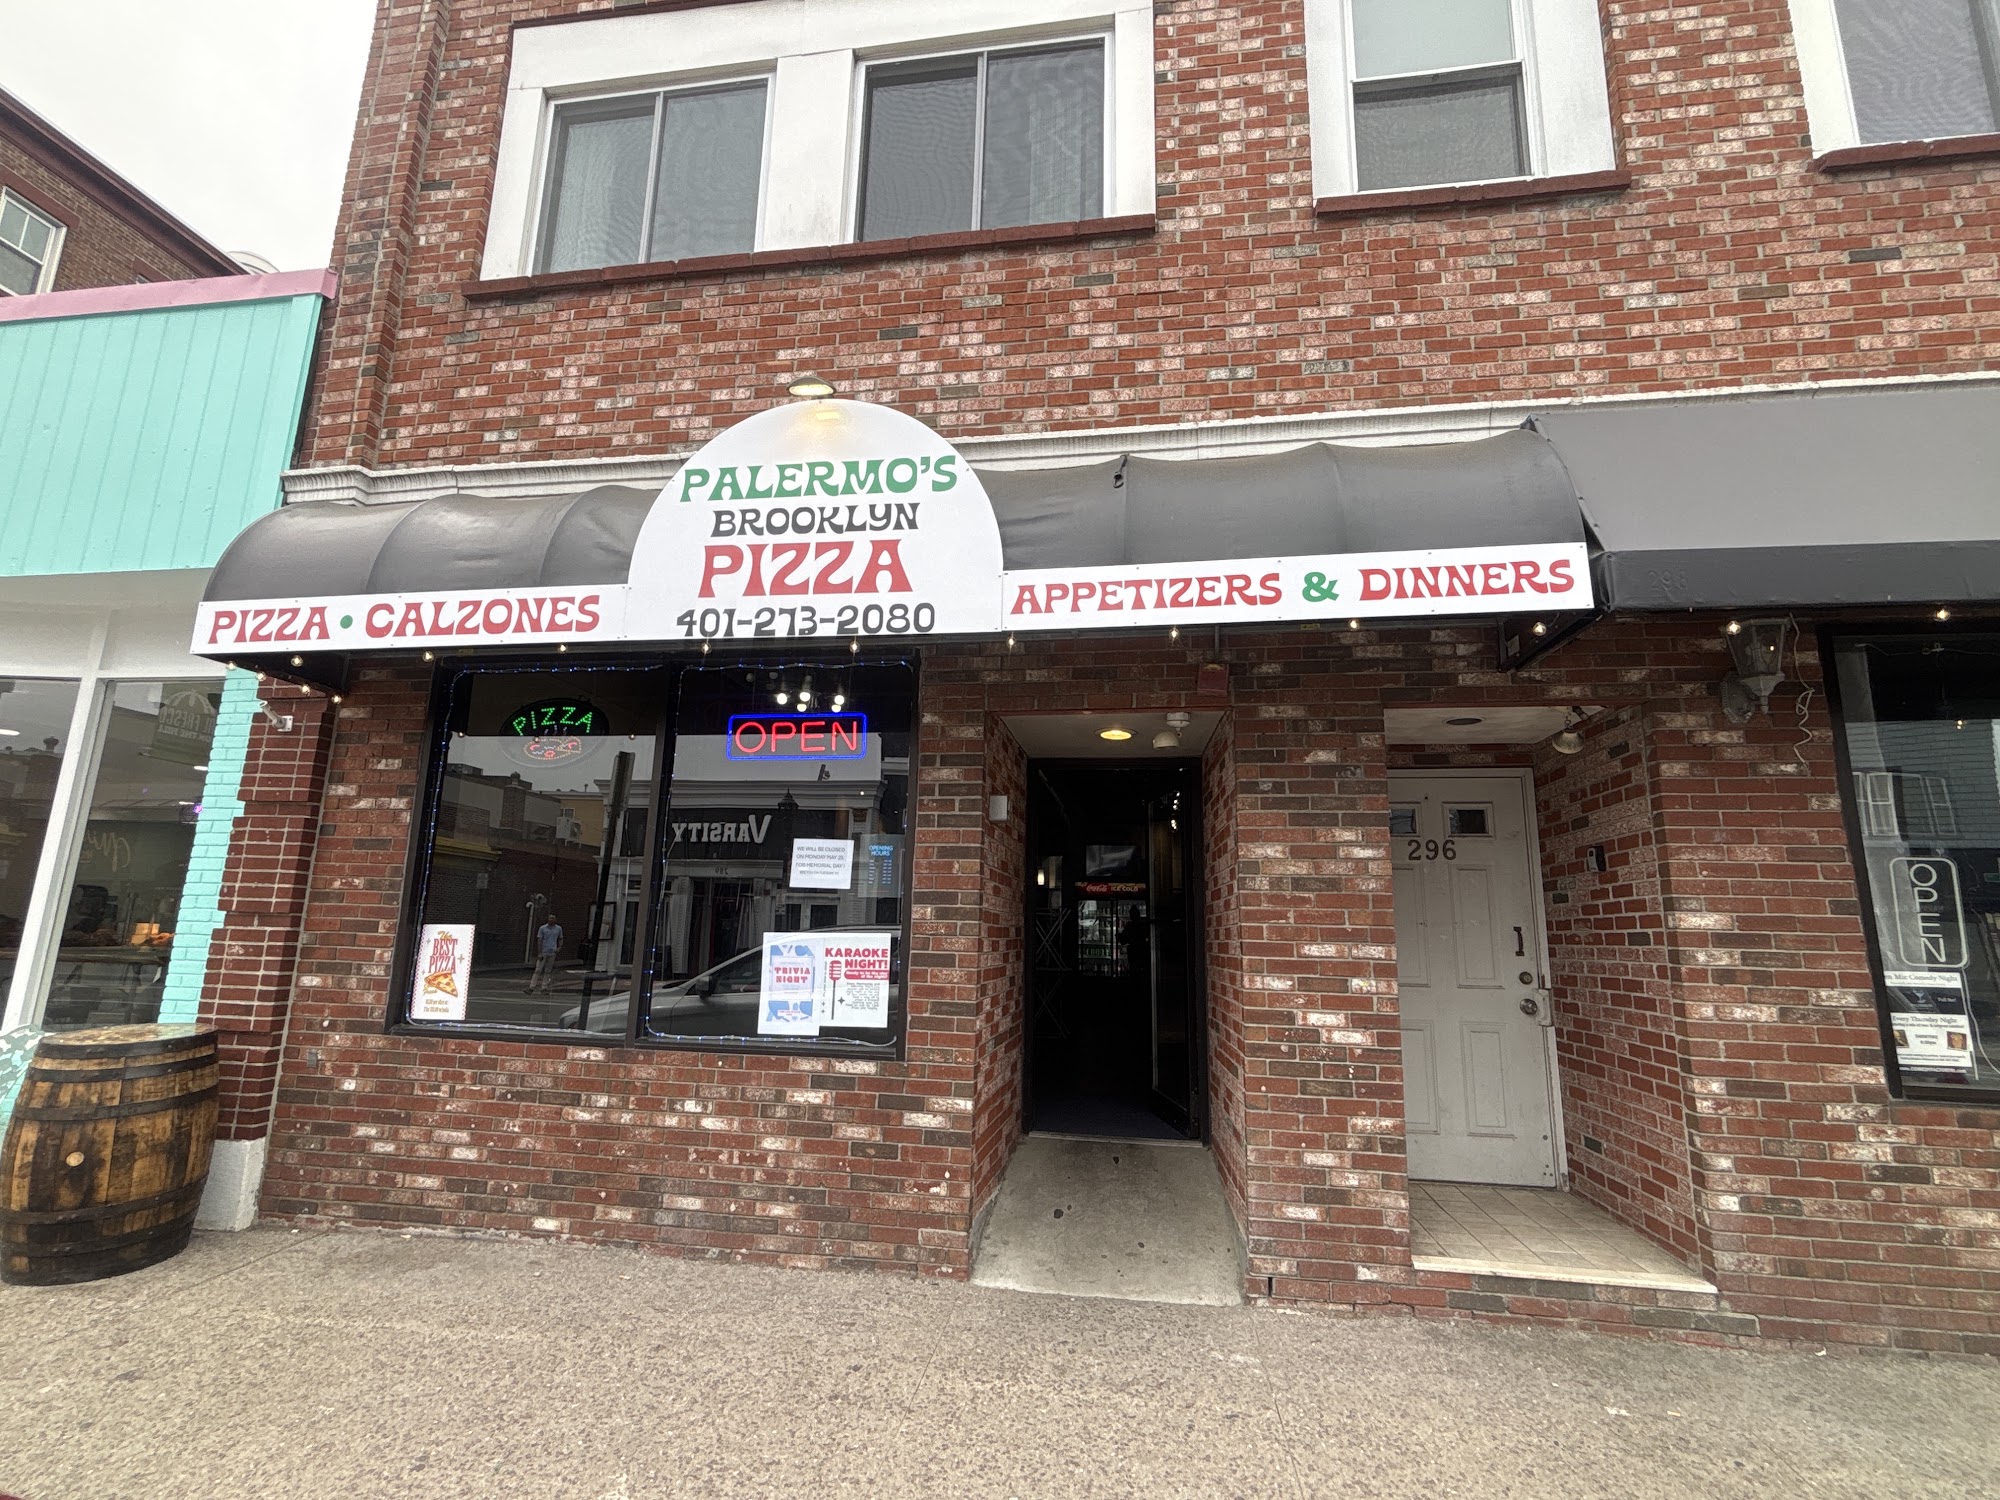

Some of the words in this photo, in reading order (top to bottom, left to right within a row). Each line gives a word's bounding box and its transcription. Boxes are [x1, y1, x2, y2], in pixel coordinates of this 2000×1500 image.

[680, 456, 957, 502] PALERMO'S
[710, 502, 921, 537] BROOKLYN
[698, 539, 913, 598] PIZZA
[1010, 573, 1282, 615] APPETIZERS
[1302, 571, 1340, 602] &
[1359, 559, 1574, 602] DINNERS
[208, 606, 330, 644] PIZZA
[365, 595, 600, 638] CALZONES
[677, 603, 934, 637] 401-273-2080
[512, 707, 593, 736] PIZZA
[735, 721, 857, 752] OPEN
[1408, 839, 1457, 860] 296
[1909, 863, 1946, 962] OPEN
[433, 939, 458, 956] BEST
[825, 948, 888, 958] KARAOKE
[428, 956, 456, 974] PIZZA
[845, 959, 888, 968] NIGHT!
[1938, 974, 1958, 983] Night
